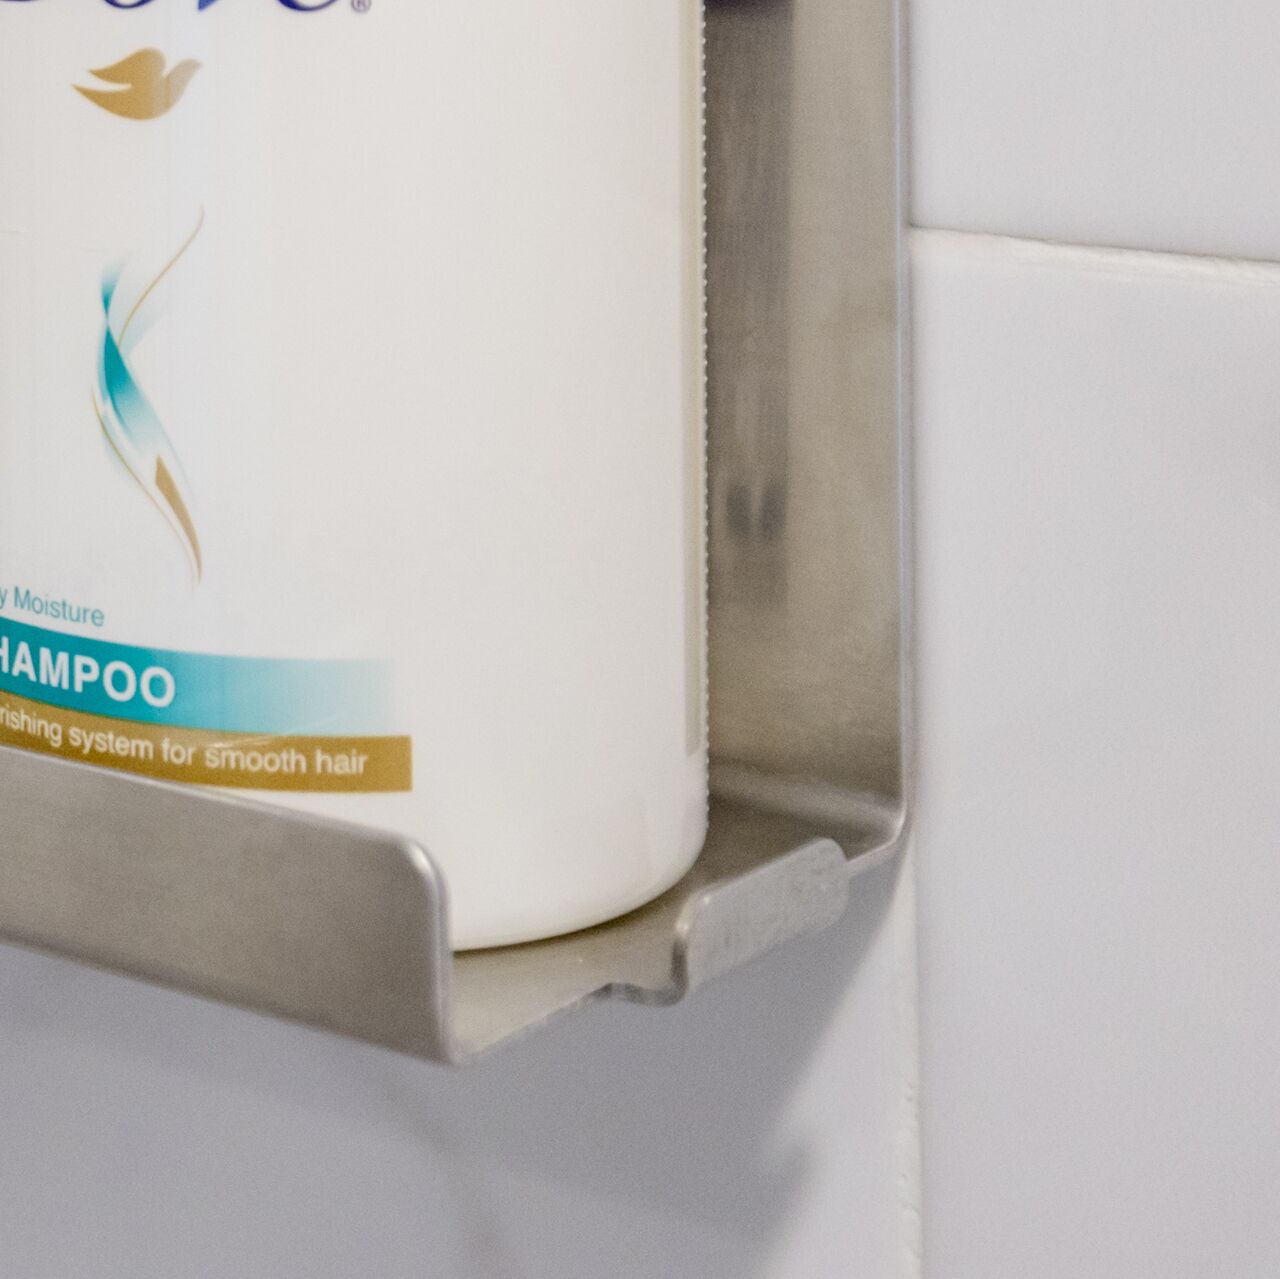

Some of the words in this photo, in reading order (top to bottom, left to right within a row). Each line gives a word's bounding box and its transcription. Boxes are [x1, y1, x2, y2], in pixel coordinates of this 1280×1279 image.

[13, 585, 106, 628] Moisture
[68, 726, 155, 760] system
[161, 735, 197, 765] for
[204, 746, 307, 774] smooth
[314, 747, 369, 775] hair
